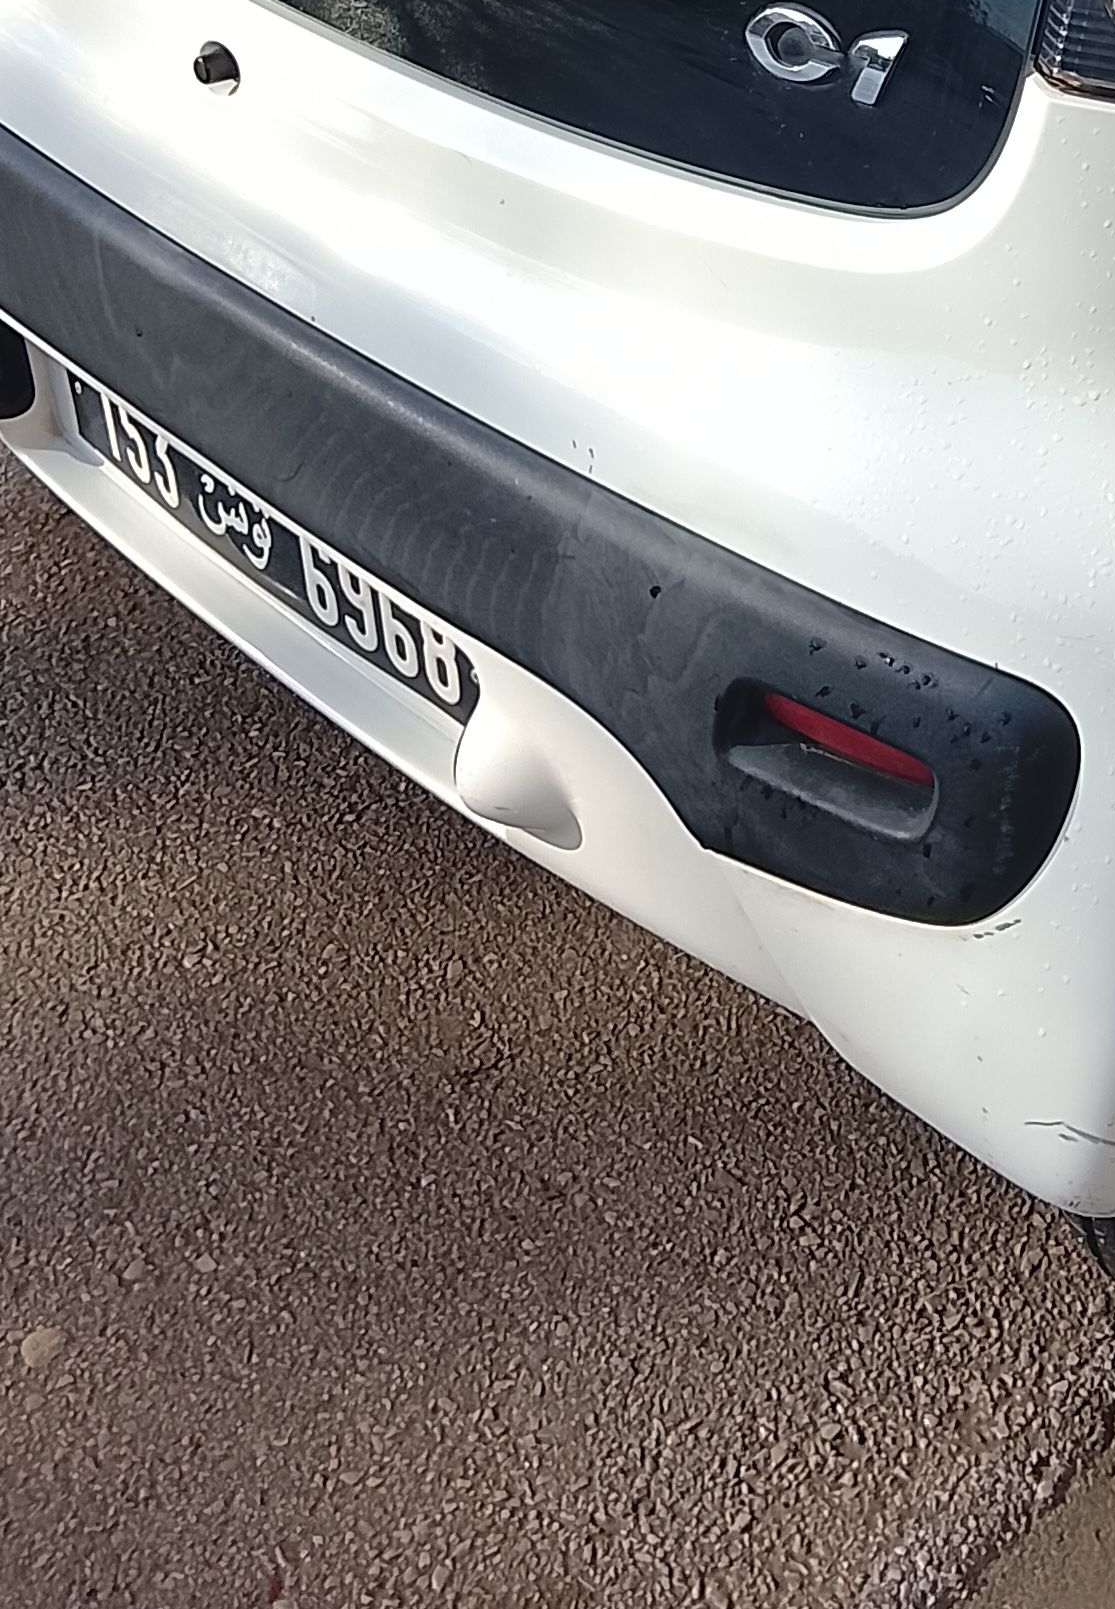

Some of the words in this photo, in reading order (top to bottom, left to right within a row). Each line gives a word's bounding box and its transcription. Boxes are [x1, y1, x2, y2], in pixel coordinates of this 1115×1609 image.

[100, 393, 179, 508] 153
[199, 474, 272, 570] تونس
[300, 536, 462, 706] 6968
